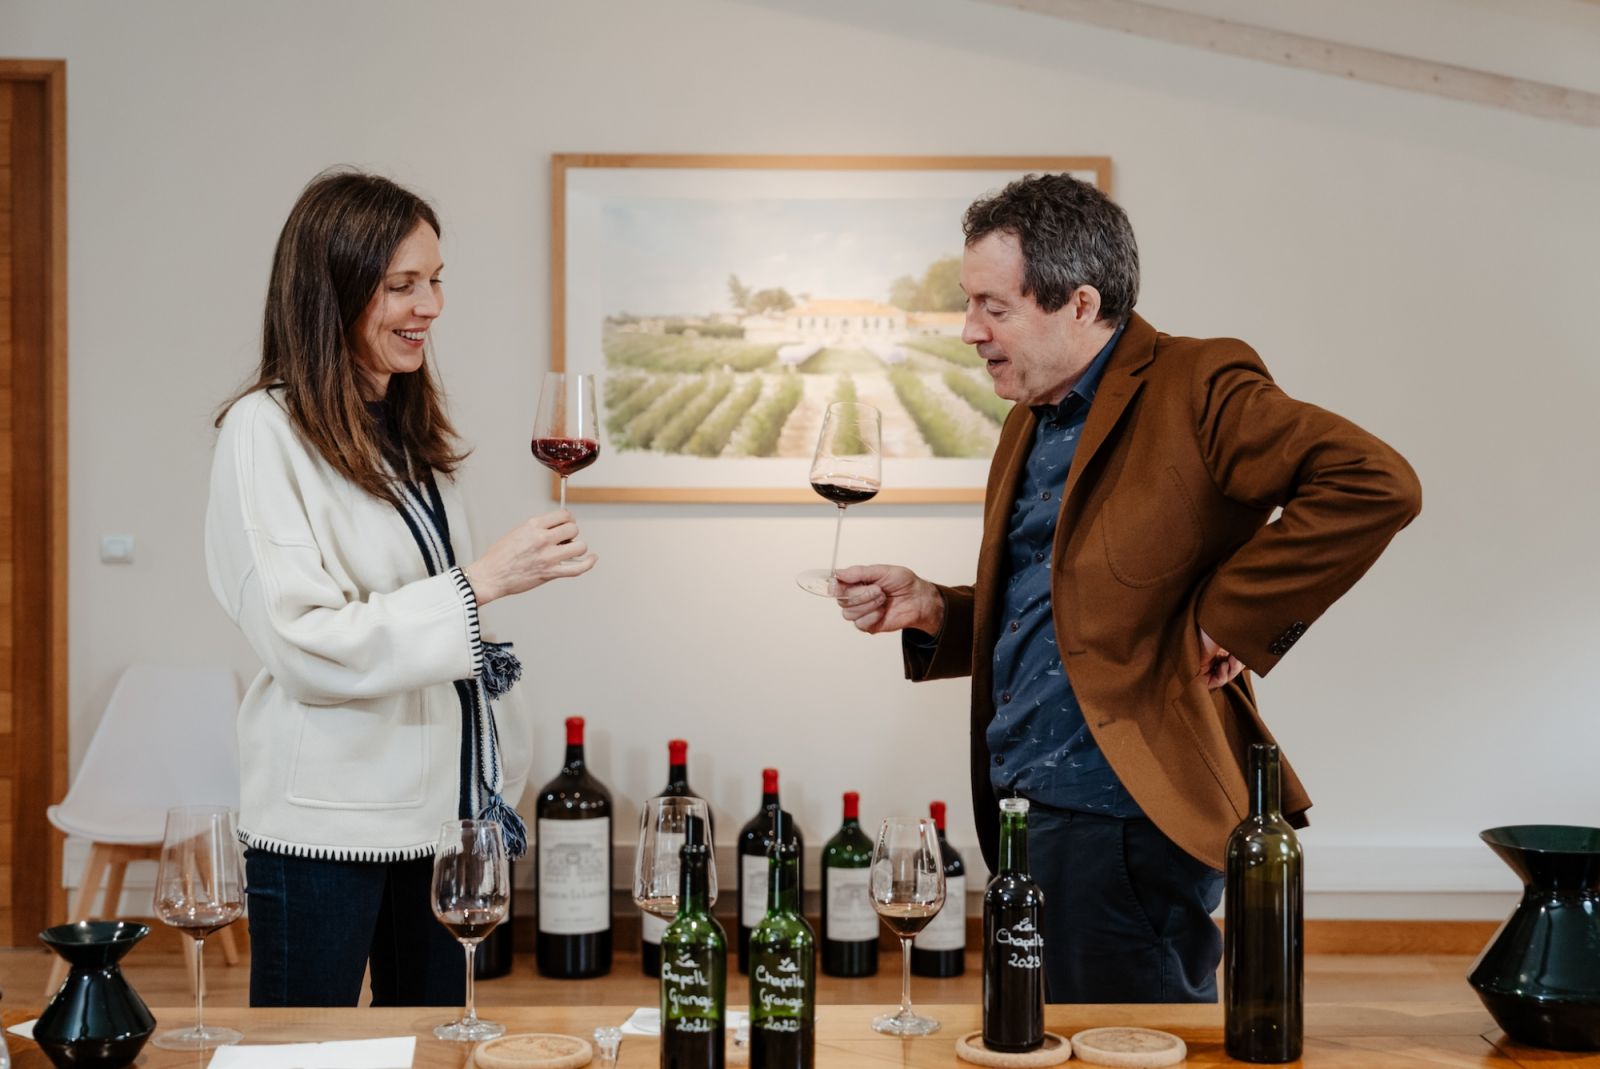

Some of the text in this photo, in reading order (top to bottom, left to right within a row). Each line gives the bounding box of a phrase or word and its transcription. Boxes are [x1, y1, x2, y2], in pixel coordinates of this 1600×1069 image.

[1012, 917, 1035, 932] La
[996, 928, 1044, 952] Chapelle
[1008, 952, 1041, 969] 2023
